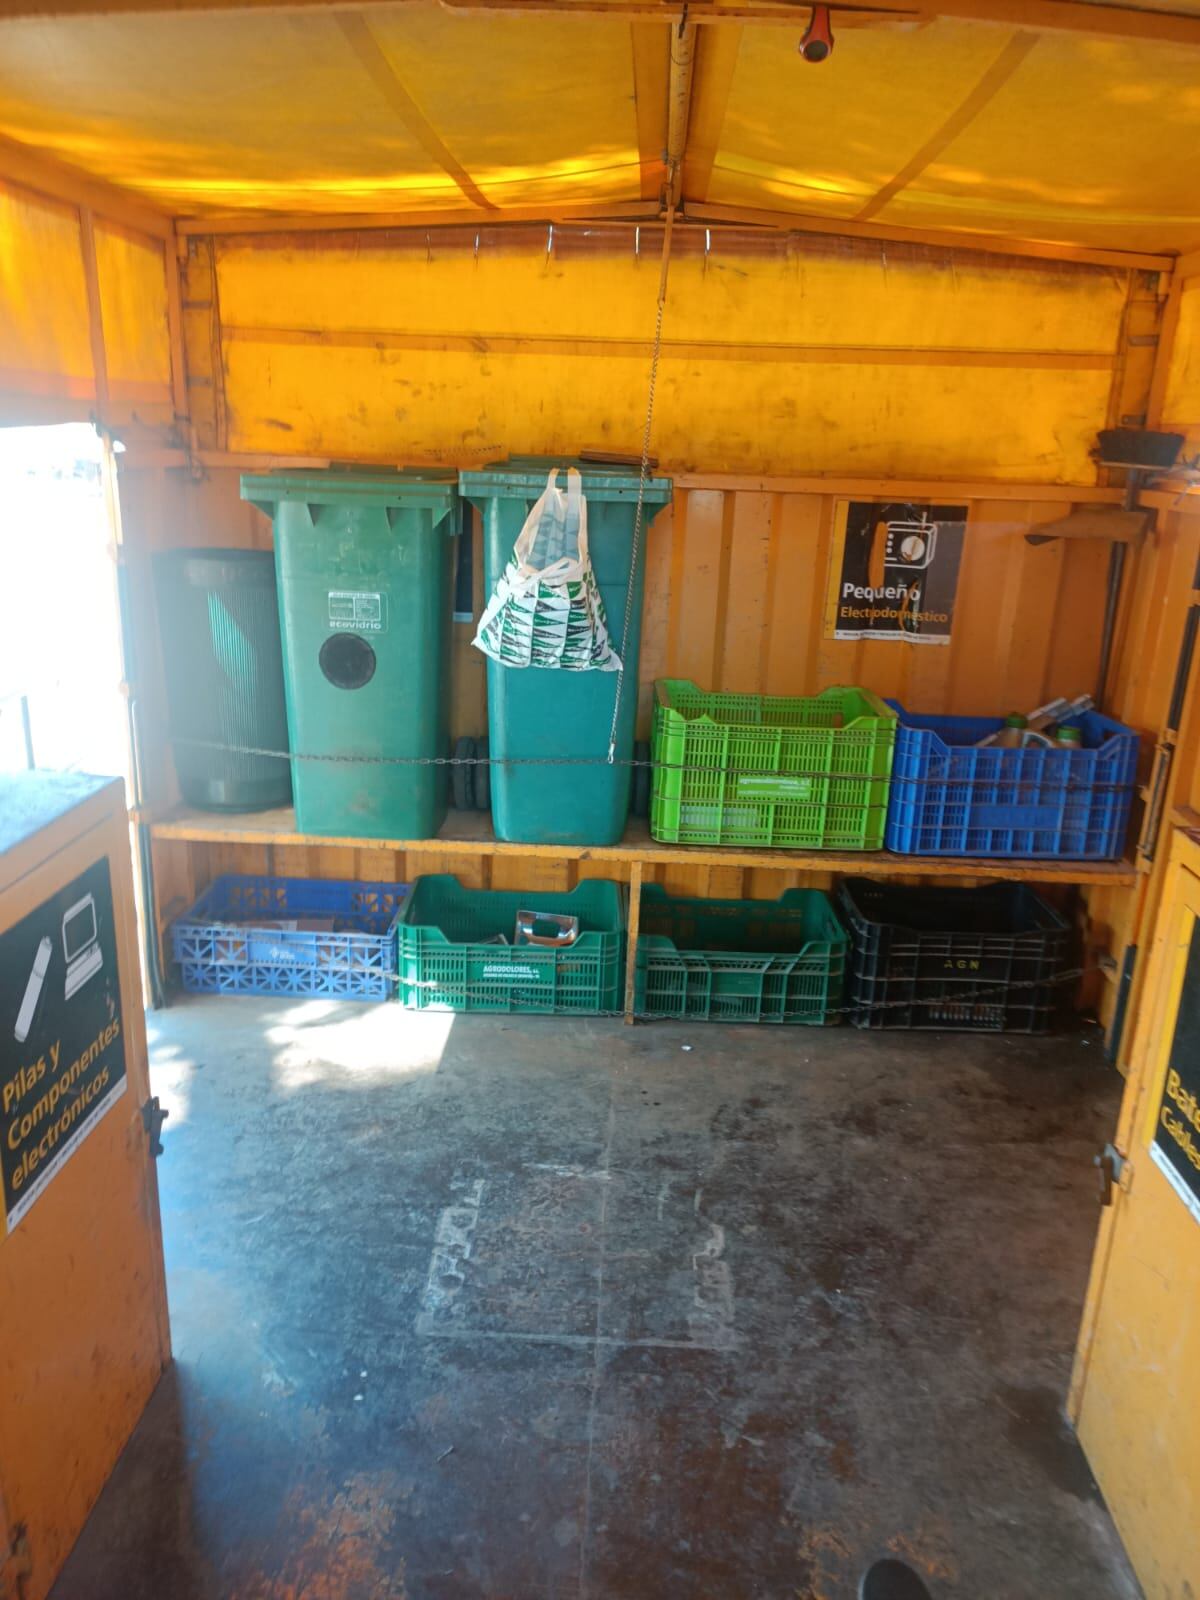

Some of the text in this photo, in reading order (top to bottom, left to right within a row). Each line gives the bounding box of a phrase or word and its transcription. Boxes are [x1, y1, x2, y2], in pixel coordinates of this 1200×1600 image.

[842, 582, 921, 602] Pequeño
[2, 1039, 61, 1114] Pilas y
[8, 1017, 120, 1151] Componentes
[11, 1065, 110, 1191] electrónicos
